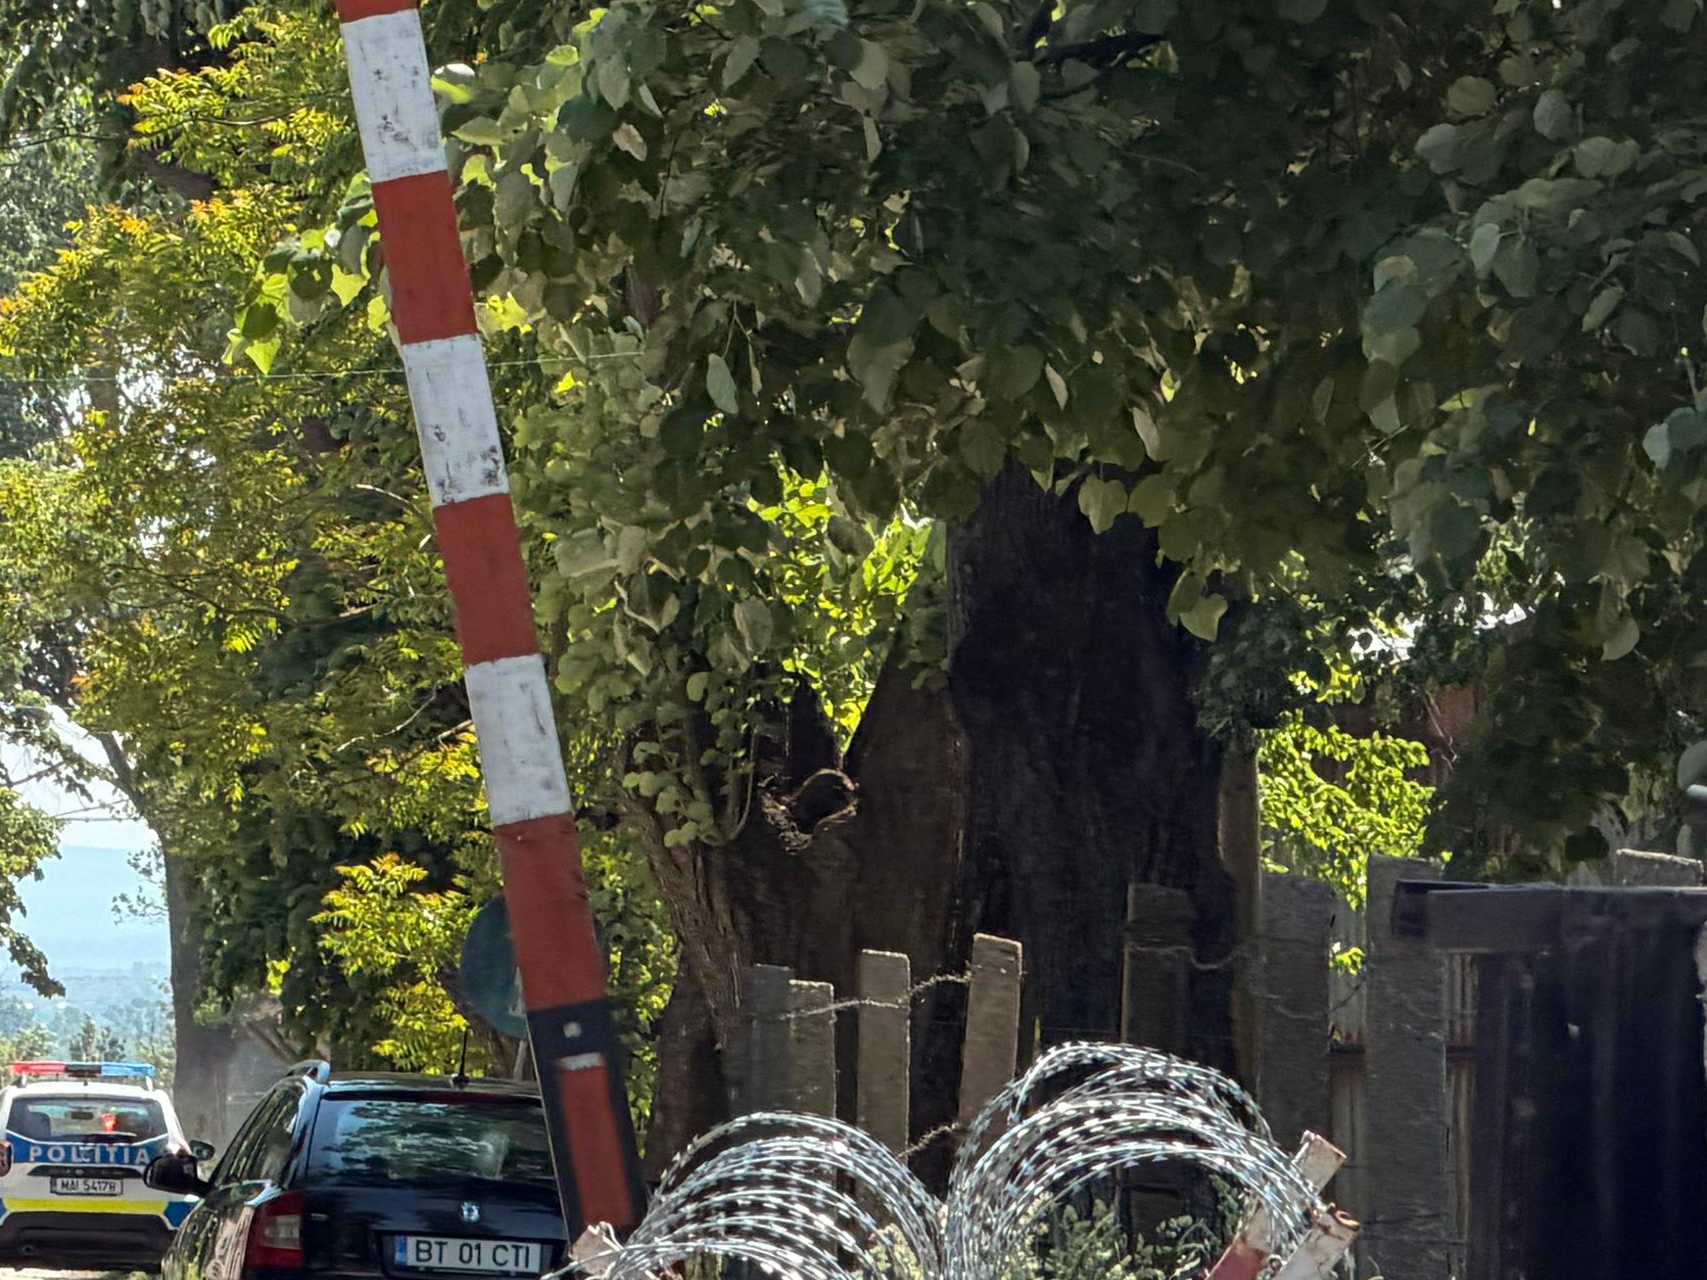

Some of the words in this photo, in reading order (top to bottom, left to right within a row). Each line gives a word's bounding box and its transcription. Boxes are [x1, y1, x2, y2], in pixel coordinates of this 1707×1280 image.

[60, 1179, 80, 1191] MAI
[415, 1239, 448, 1265] BT
[458, 1242, 482, 1266] 01
[491, 1244, 530, 1269] CTI
